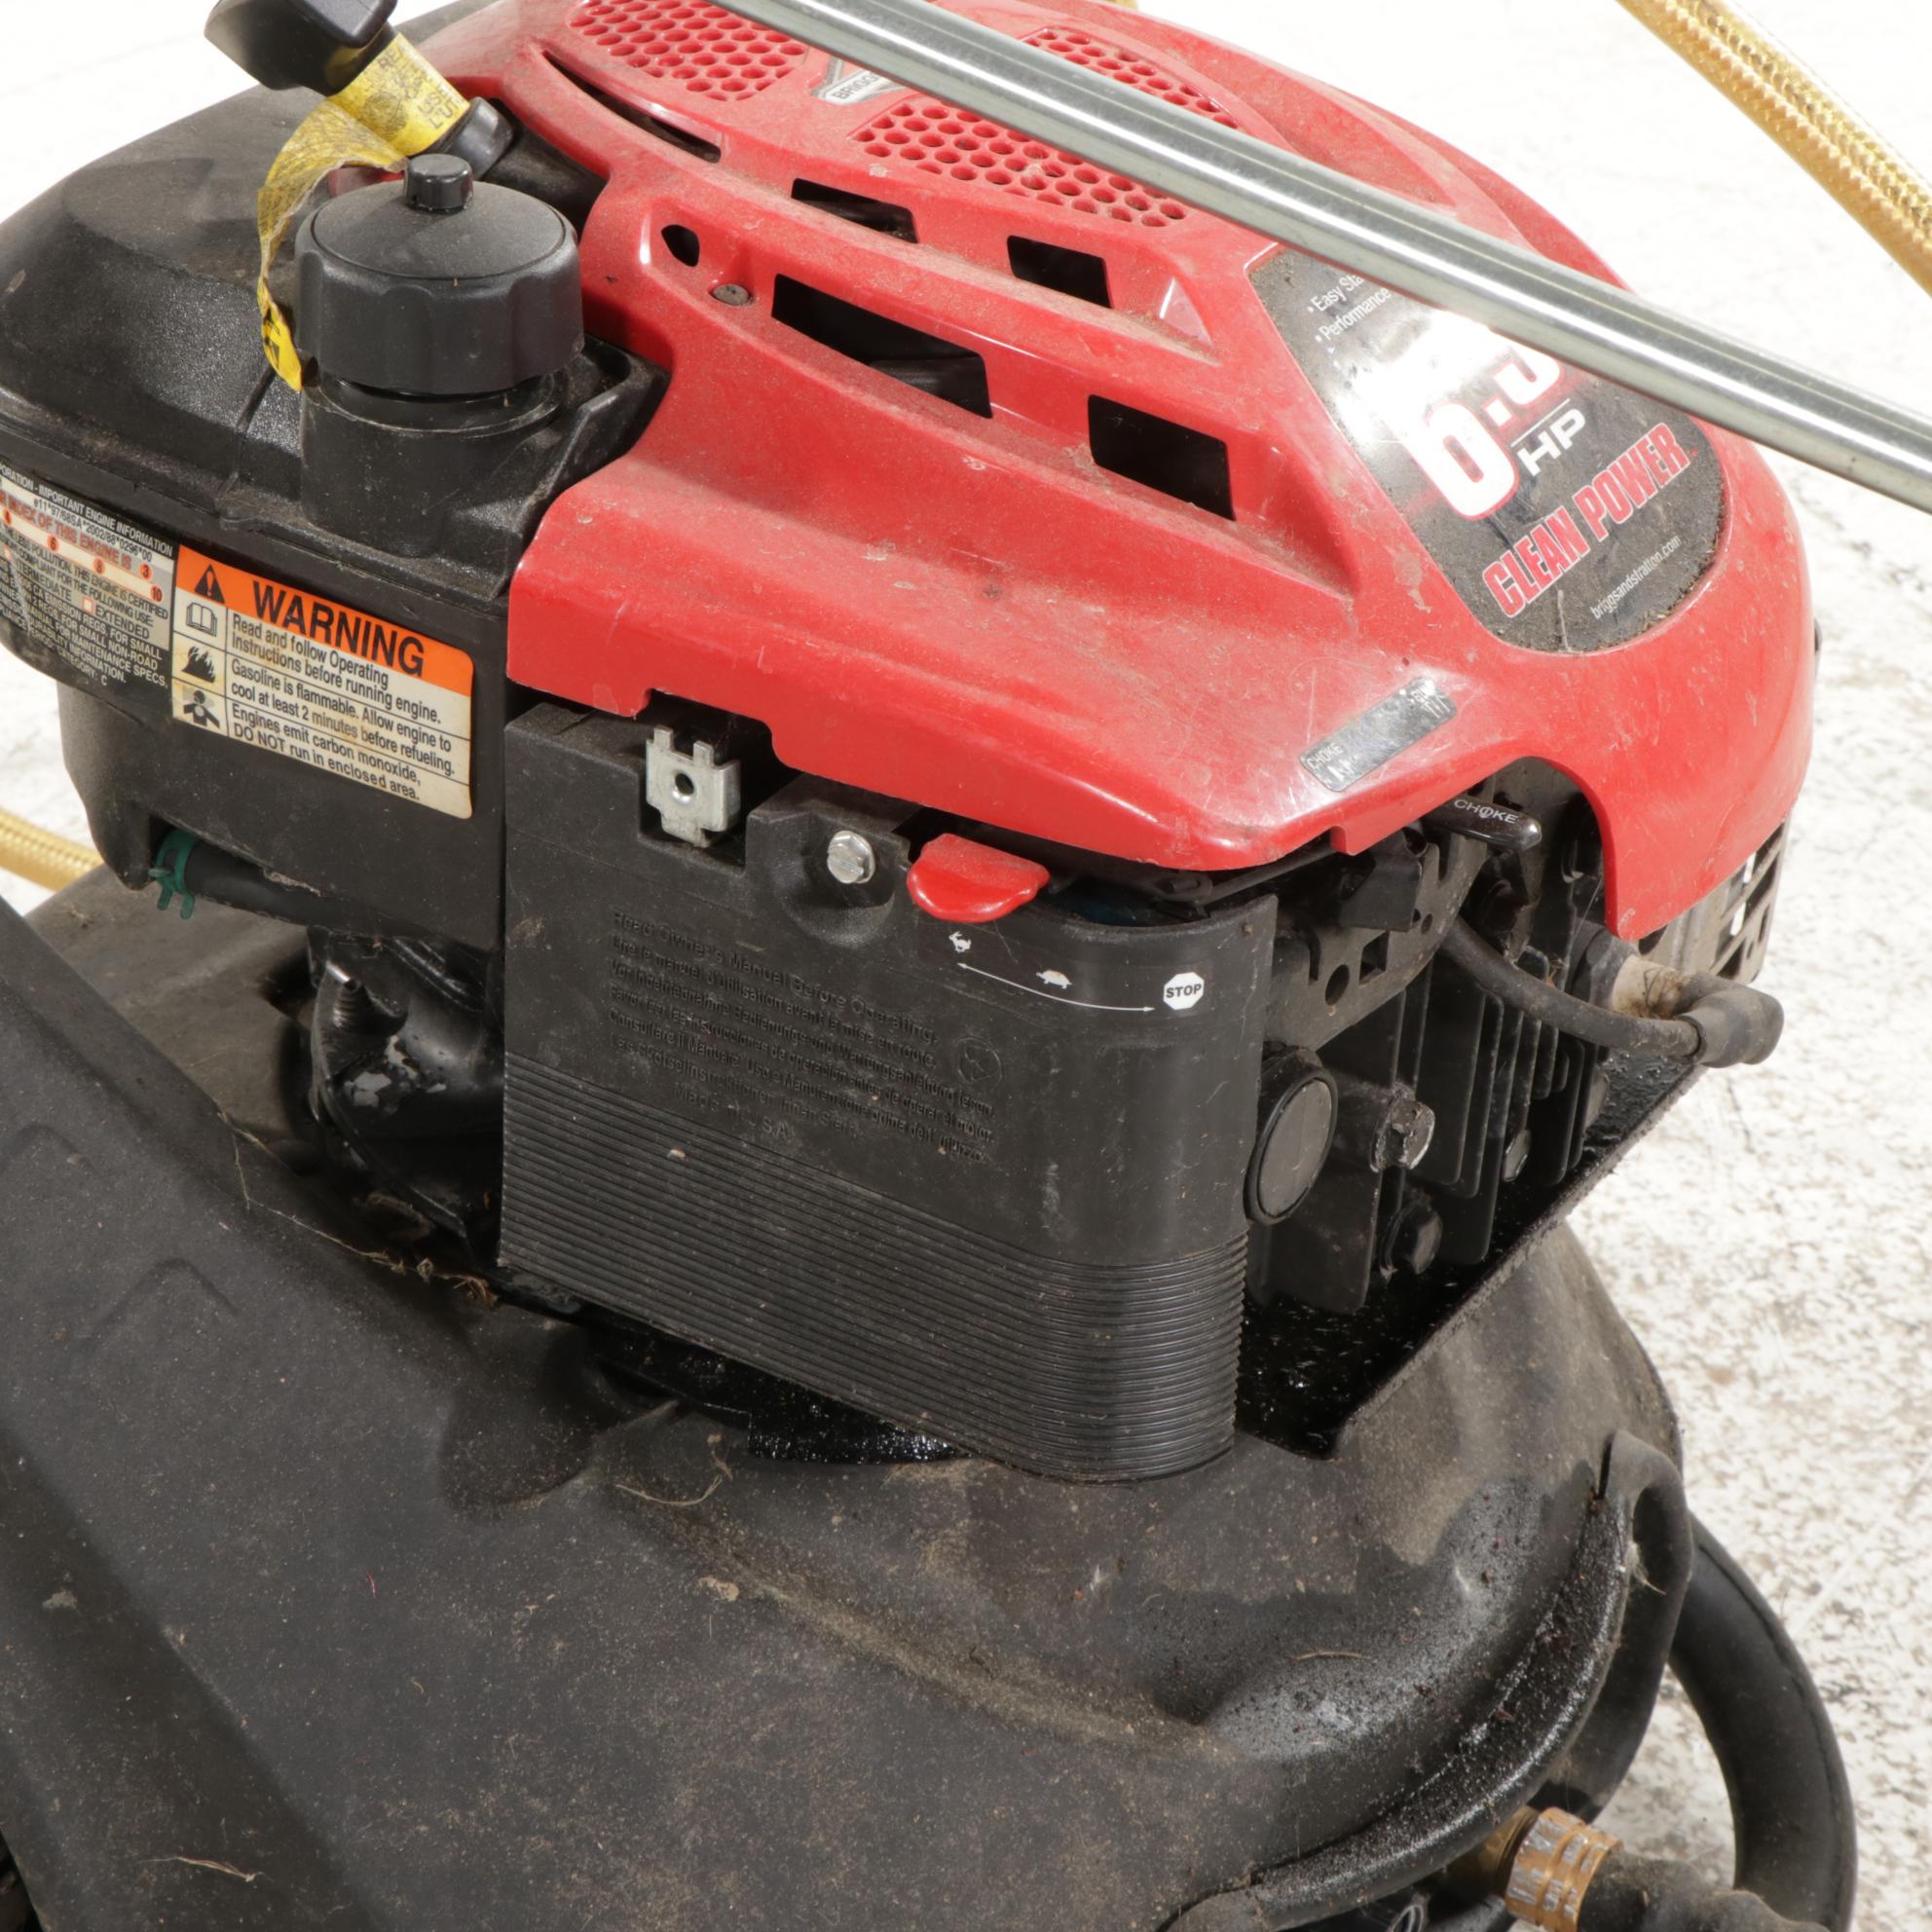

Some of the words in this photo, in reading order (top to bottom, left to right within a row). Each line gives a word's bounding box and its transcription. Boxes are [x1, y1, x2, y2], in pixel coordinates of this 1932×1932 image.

[1310, 285, 1347, 312] Easy
[1339, 275, 1364, 291] Sta
[1319, 287, 1393, 341] Performance
[1516, 408, 1587, 475] HP
[39, 483, 86, 514] IMPORTANT
[86, 506, 116, 531] ENGINE
[117, 520, 173, 557] INFORMATION
[1482, 505, 1591, 618] CLEAN
[1572, 422, 1691, 542] POWER
[129, 592, 168, 620] CERTIFIED
[150, 585, 163, 603] 10
[1590, 535, 1683, 620] briggsandstratton.com
[55, 620, 71, 638] FOR
[71, 630, 131, 673] MAINTENANCE
[132, 665, 168, 690] SPECS.
[61, 614, 78, 631] FOR
[79, 624, 110, 649] SMALL
[109, 639, 158, 672] NON-ROAD
[95, 603, 150, 640] EXTENDED
[109, 627, 129, 645] FOR
[130, 634, 163, 661] SMALL
[233, 612, 263, 641] Read
[265, 629, 287, 650] and
[291, 636, 327, 664] follow
[330, 650, 389, 691] Operating
[253, 579, 425, 679] WARNING
[231, 658, 281, 690] Gasoline
[283, 677, 294, 695] is
[296, 683, 359, 720] flammable.
[362, 707, 394, 732] Allow
[396, 723, 436, 747] engine
[439, 734, 452, 753] to
[232, 630, 302, 674] Instructions
[305, 658, 343, 689] before
[346, 678, 392, 711] running
[395, 696, 441, 724] engine.
[231, 682, 256, 702] cool
[258, 691, 270, 708] at
[272, 692, 300, 719] least
[302, 705, 310, 722] 2
[312, 711, 358, 739] minutes
[360, 725, 398, 754] before
[400, 743, 456, 777] refueling.
[232, 702, 281, 734] Engines
[282, 724, 311, 744] emit
[313, 734, 354, 760] carbon
[357, 751, 422, 787] monoxide,
[234, 723, 254, 742] DO
[257, 730, 286, 753] NOT
[289, 744, 311, 761] run
[313, 749, 325, 766] in
[328, 758, 388, 789] enclosed
[390, 780, 421, 800] area.
[1307, 741, 1346, 771] CHOKE
[1454, 799, 1519, 825] CHOKE
[727, 950, 787, 986] Manual
[1165, 983, 1203, 999] STOP
